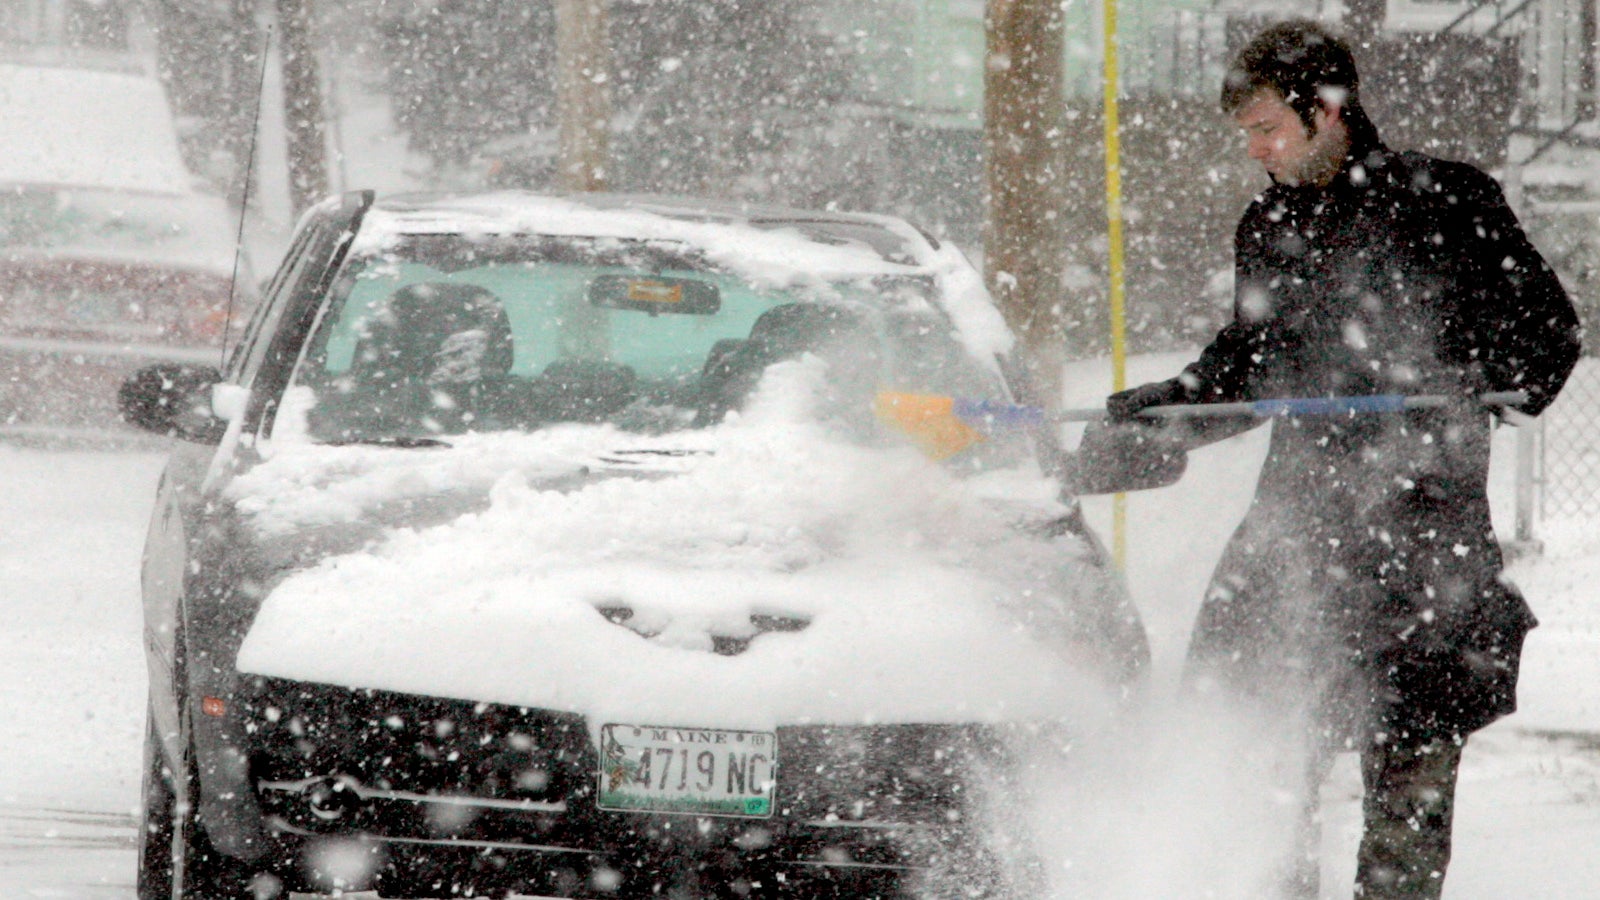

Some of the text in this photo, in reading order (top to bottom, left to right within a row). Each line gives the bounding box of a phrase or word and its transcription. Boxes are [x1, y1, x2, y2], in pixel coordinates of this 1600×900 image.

[652, 730, 727, 744] MAINE
[636, 747, 768, 795] 4719 NC
